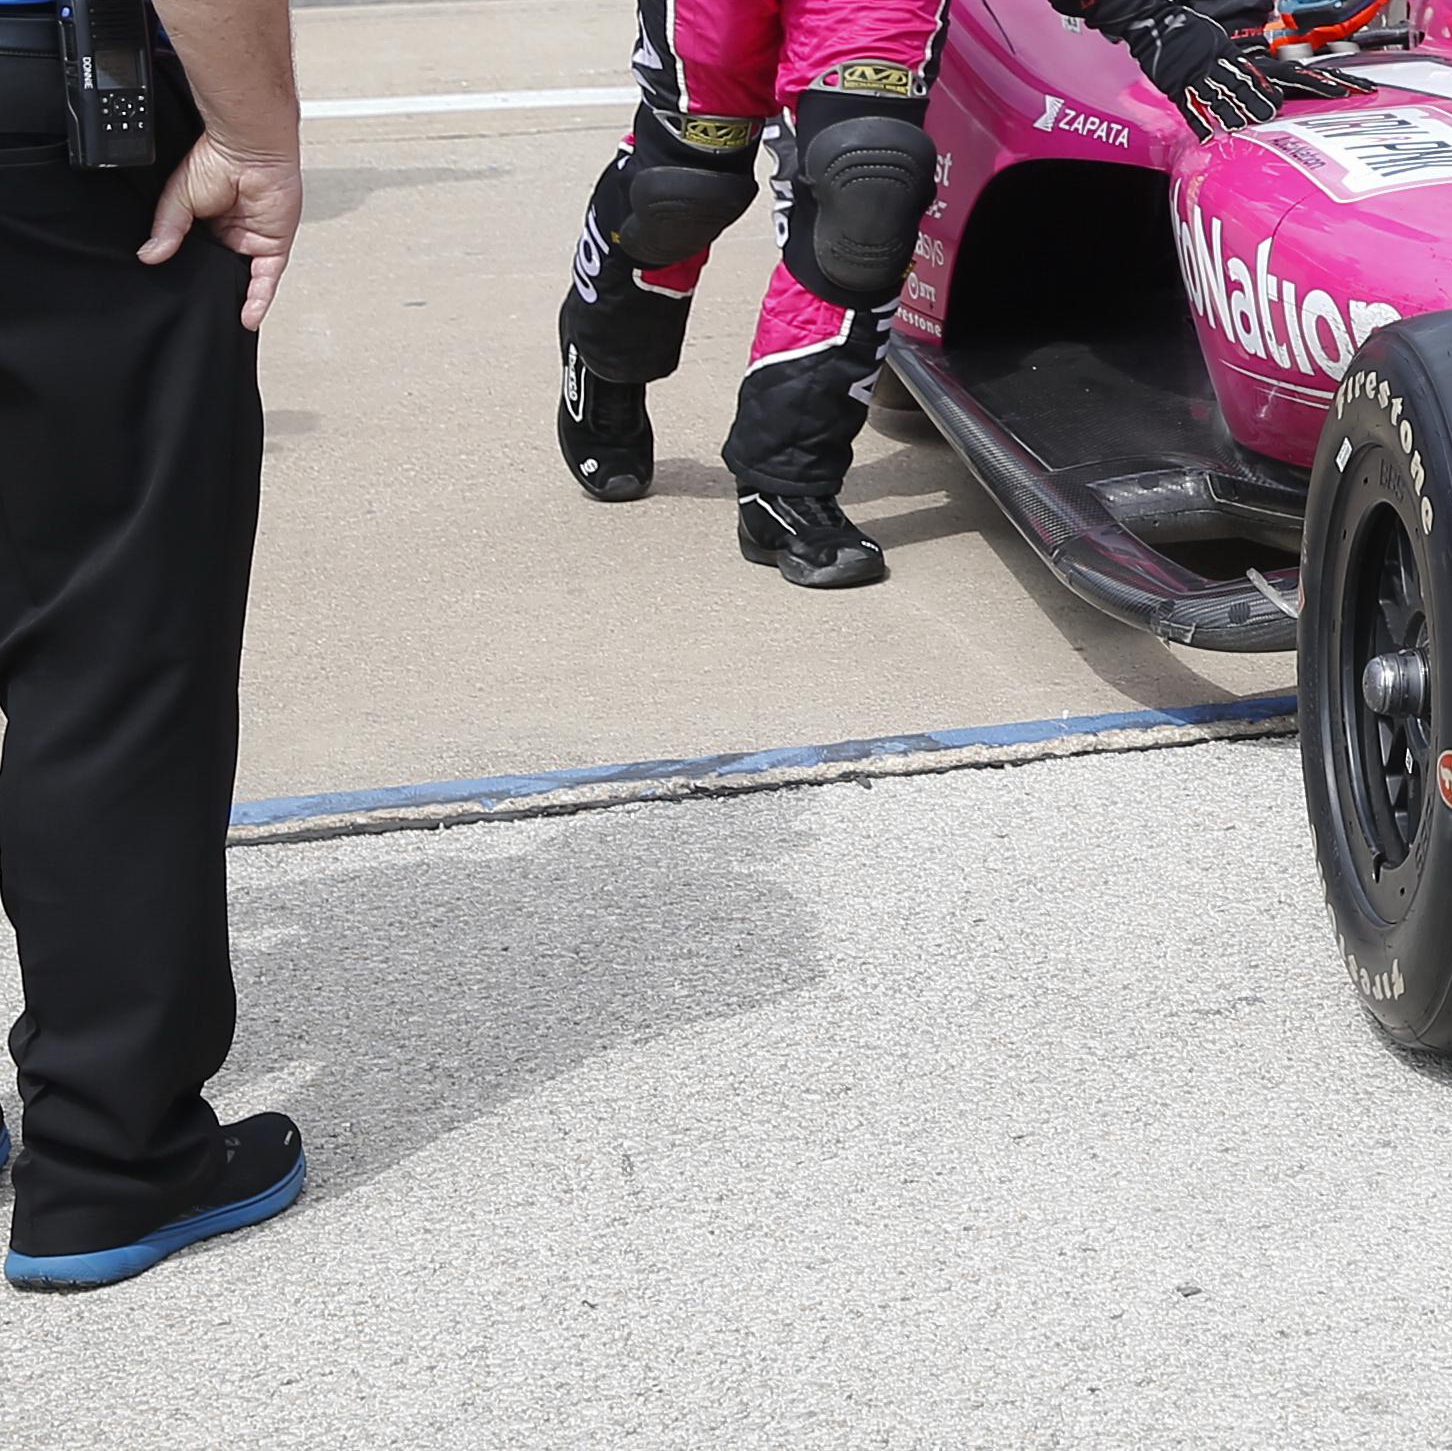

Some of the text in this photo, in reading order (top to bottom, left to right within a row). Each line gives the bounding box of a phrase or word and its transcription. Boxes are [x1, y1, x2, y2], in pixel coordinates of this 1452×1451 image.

[1058, 109, 1131, 149] ZAPATA
[894, 306, 942, 338] restone
[1336, 370, 1434, 536] Firestone
